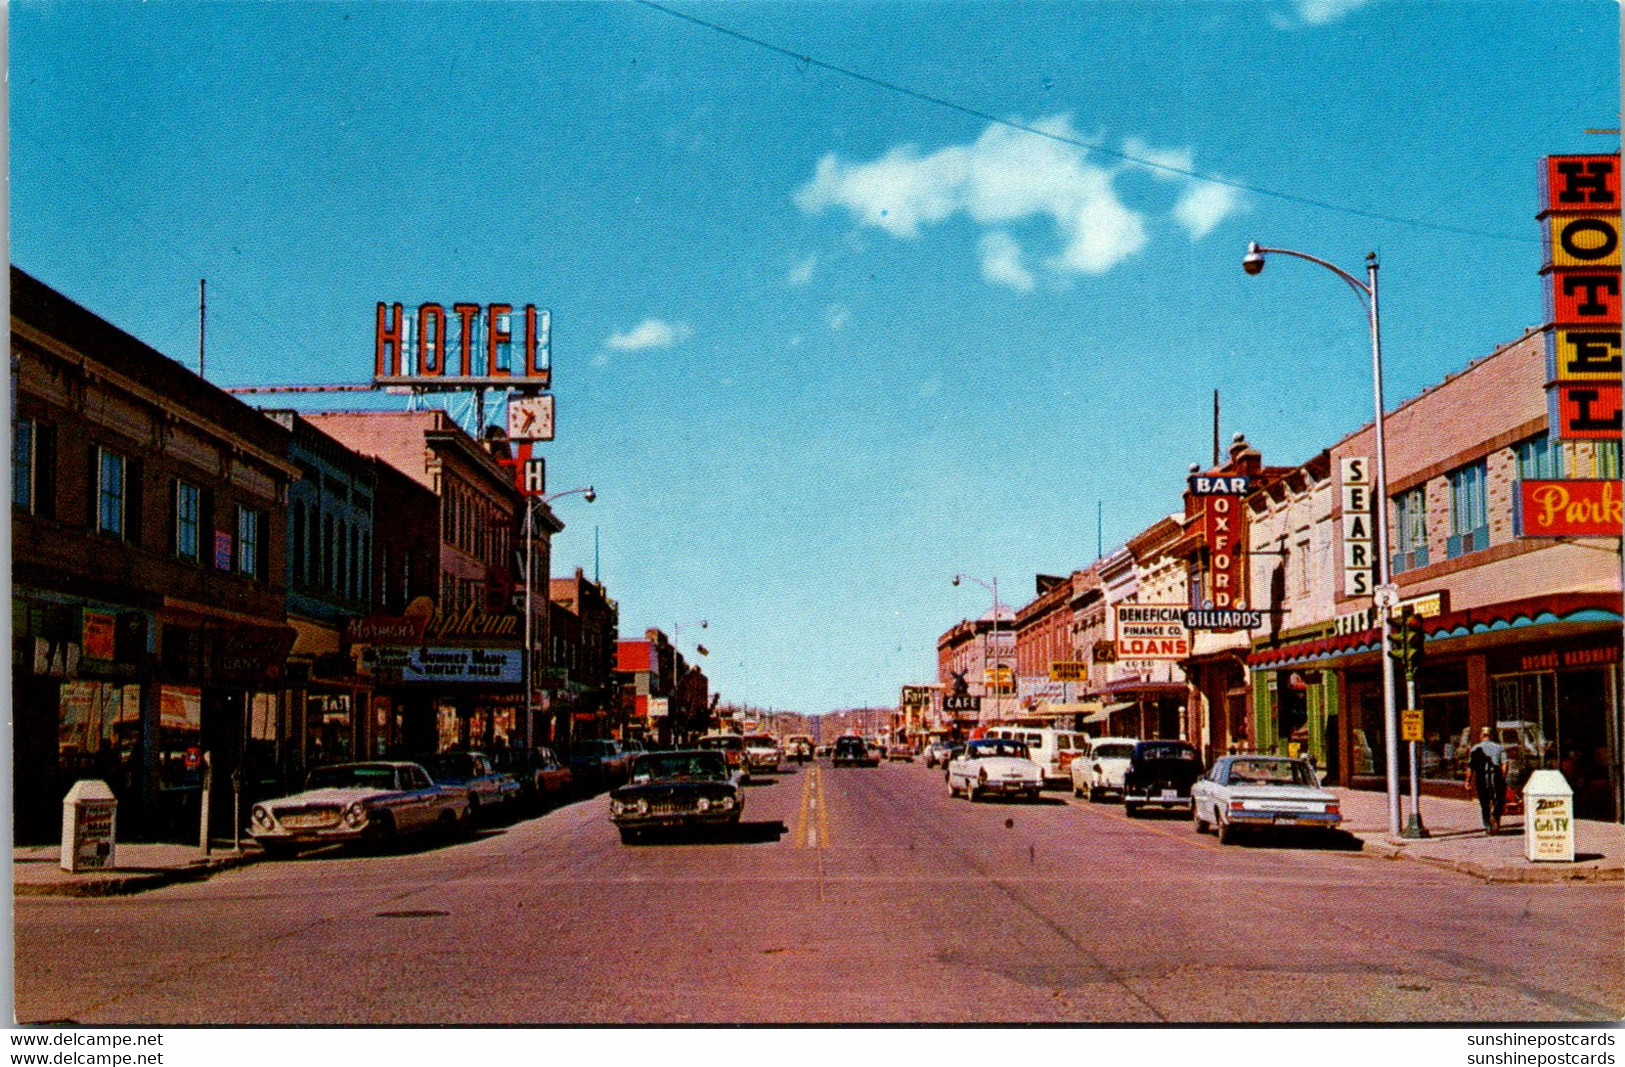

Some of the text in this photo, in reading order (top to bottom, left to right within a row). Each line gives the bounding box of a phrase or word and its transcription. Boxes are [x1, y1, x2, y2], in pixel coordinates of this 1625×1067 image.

[1557, 162, 1622, 432] HOTEL
[375, 301, 550, 377] HOTEL
[1196, 477, 1248, 494] BAR
[1532, 481, 1622, 527] Park
[1349, 460, 1367, 594] SEARS
[1213, 498, 1230, 607] OXFORD
[1124, 626, 1183, 636] FINANCE CO.
[1186, 610, 1261, 628] BILLIARDS
[1119, 640, 1188, 654] LOANS
[946, 697, 977, 708] CAFE
